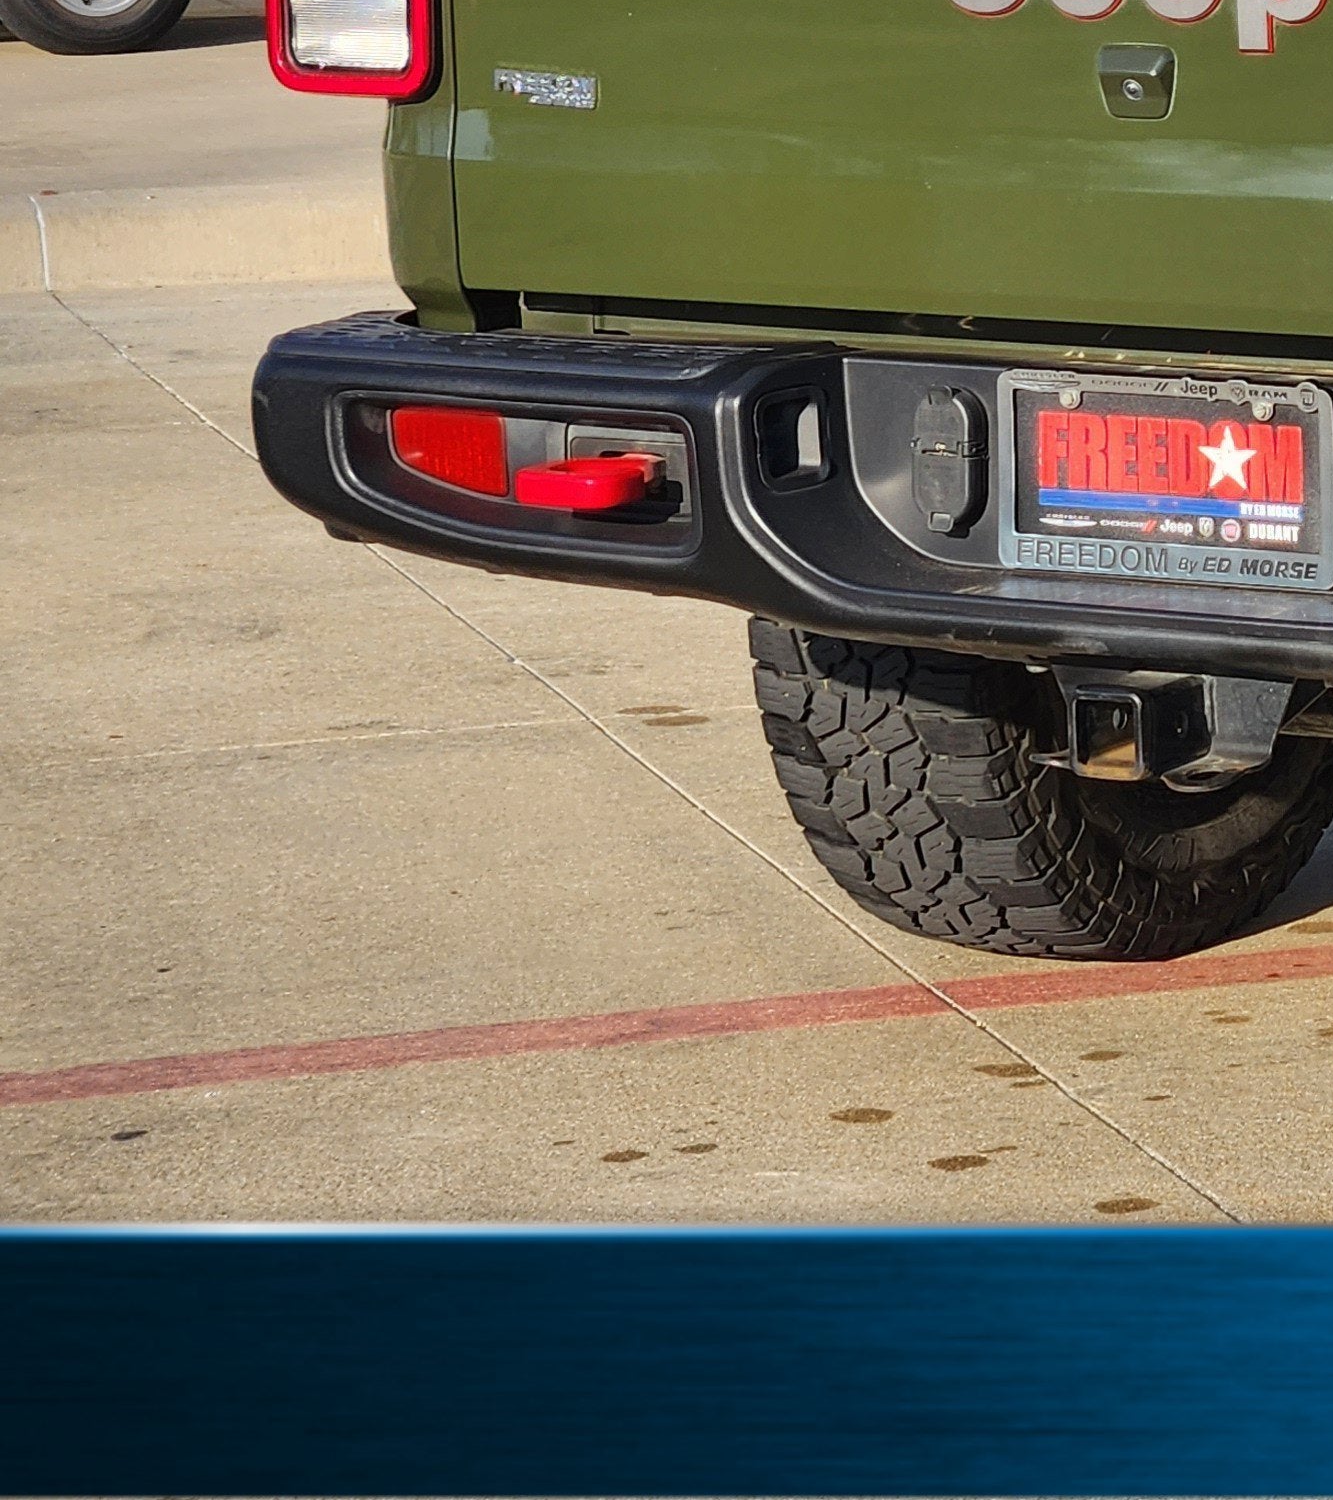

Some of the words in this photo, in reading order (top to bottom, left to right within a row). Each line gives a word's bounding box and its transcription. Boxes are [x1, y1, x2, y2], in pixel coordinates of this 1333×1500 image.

[1180, 380, 1218, 399] Jeep
[1037, 410, 1304, 504] FREEDOM
[1159, 518, 1194, 536] Jeep
[1248, 522, 1300, 542] DURANT
[1016, 538, 1170, 576] FREEDOM
[1202, 556, 1231, 574] ED
[1239, 558, 1319, 581] MORSE
